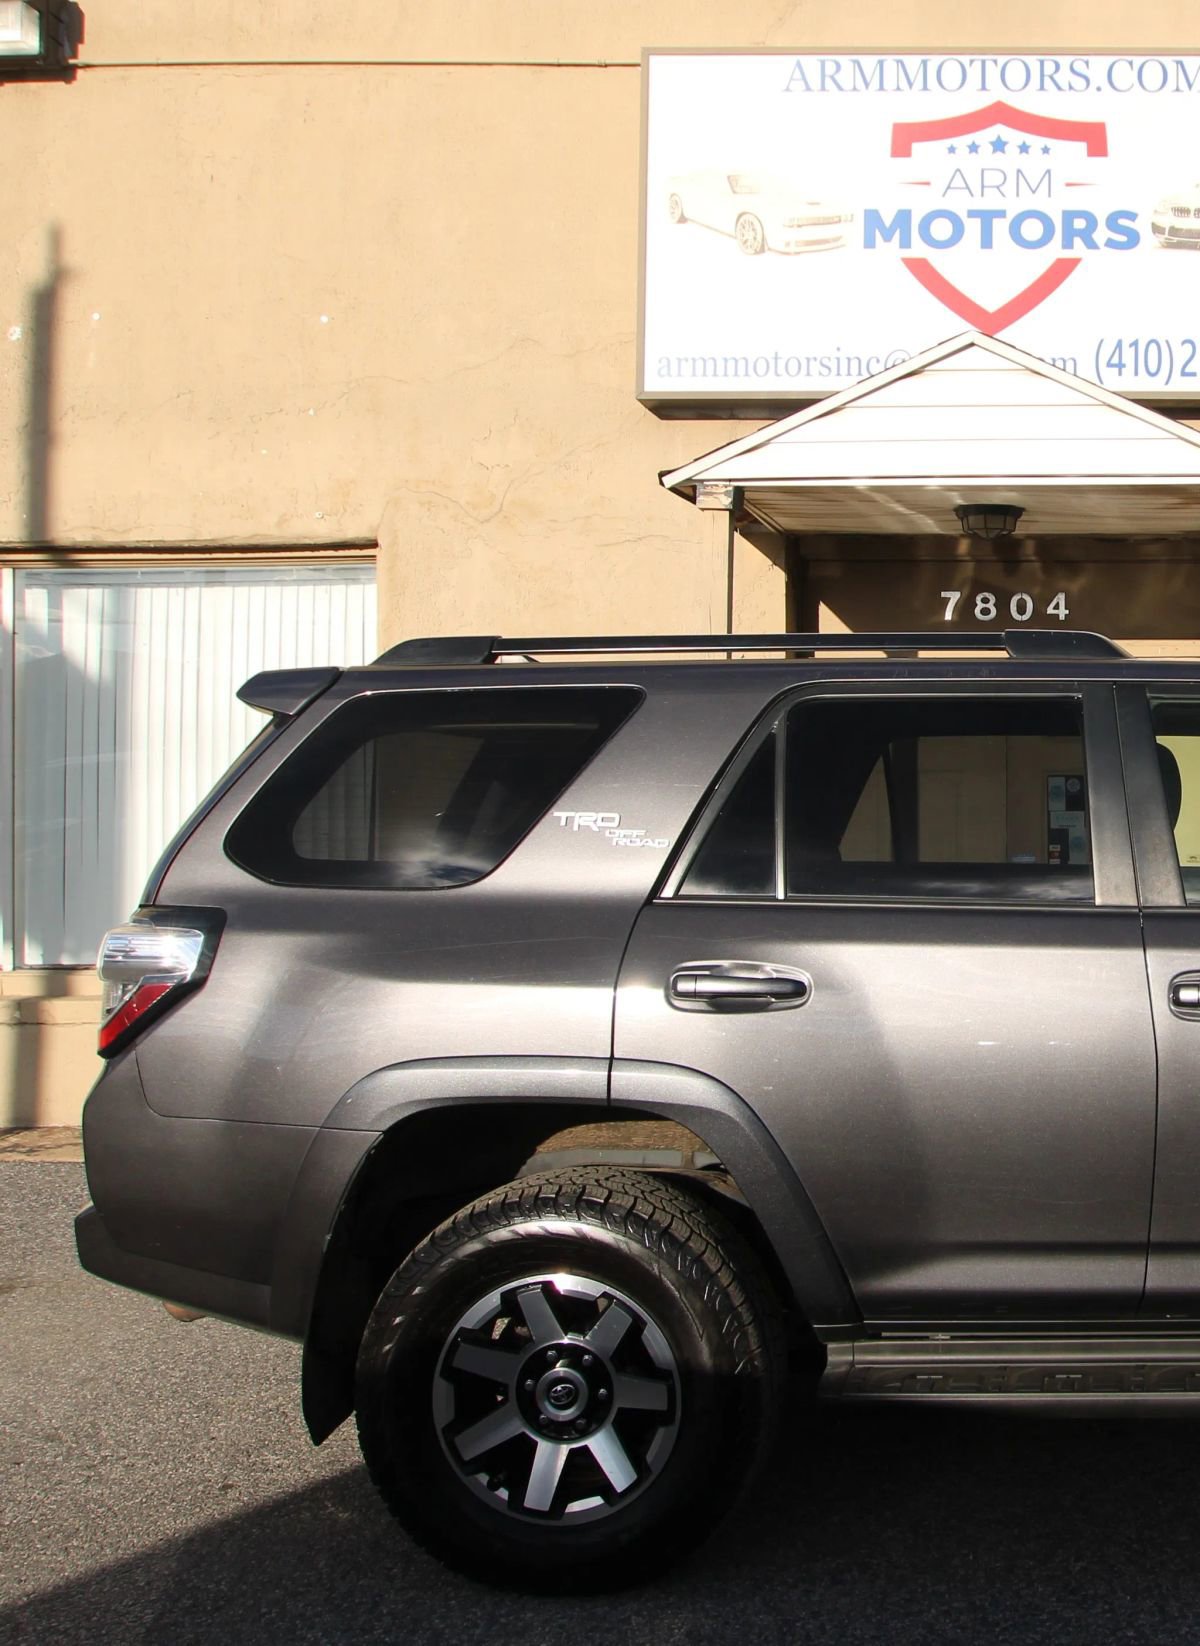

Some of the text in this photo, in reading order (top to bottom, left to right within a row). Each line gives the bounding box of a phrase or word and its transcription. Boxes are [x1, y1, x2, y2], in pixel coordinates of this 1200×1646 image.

[942, 168, 1052, 199] ARM
[863, 208, 1141, 251] MOTORS
[940, 591, 1070, 621] 7804
[553, 811, 621, 832] TRD
[605, 829, 646, 838] OFF
[612, 838, 670, 848] ROAD
